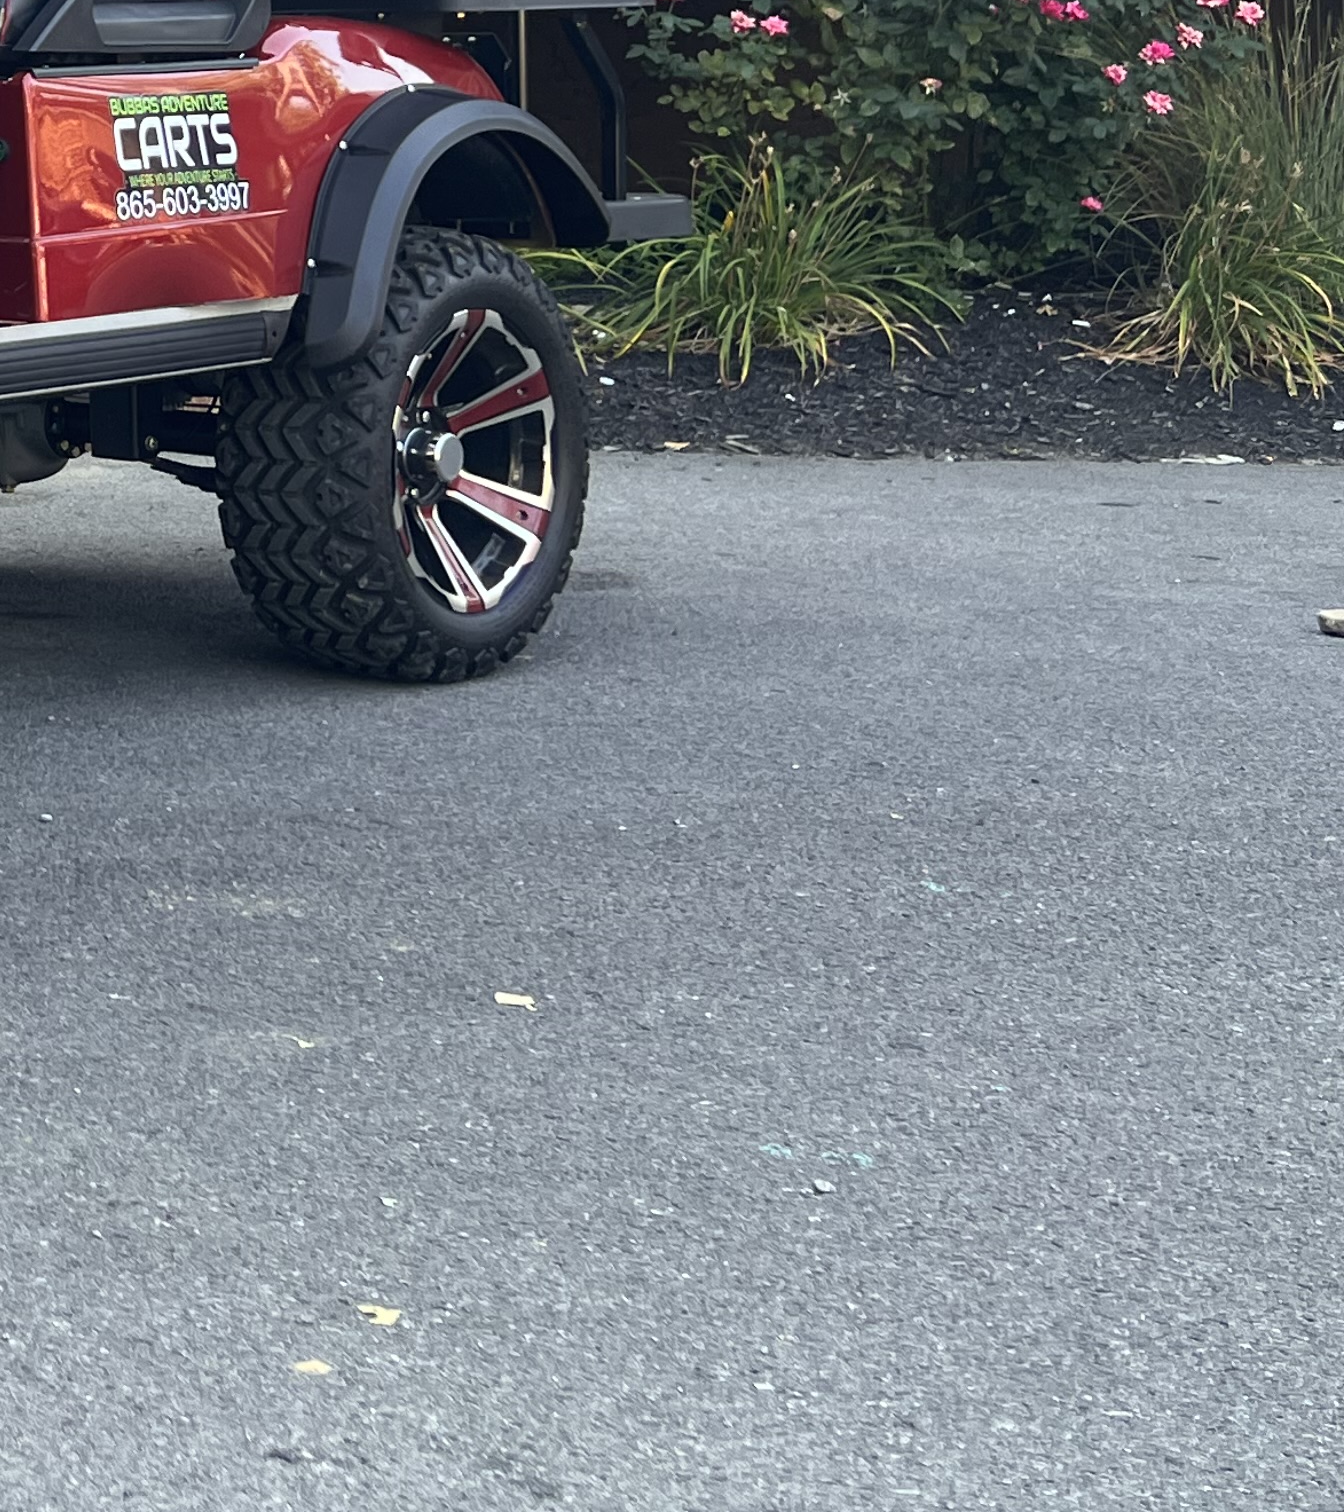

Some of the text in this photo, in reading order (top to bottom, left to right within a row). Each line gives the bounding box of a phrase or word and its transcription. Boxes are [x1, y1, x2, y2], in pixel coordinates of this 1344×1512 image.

[109, 94, 229, 116] BUBBAS ADVENTURE
[113, 113, 239, 172] CARTS
[116, 181, 250, 221] 865-603-3997
